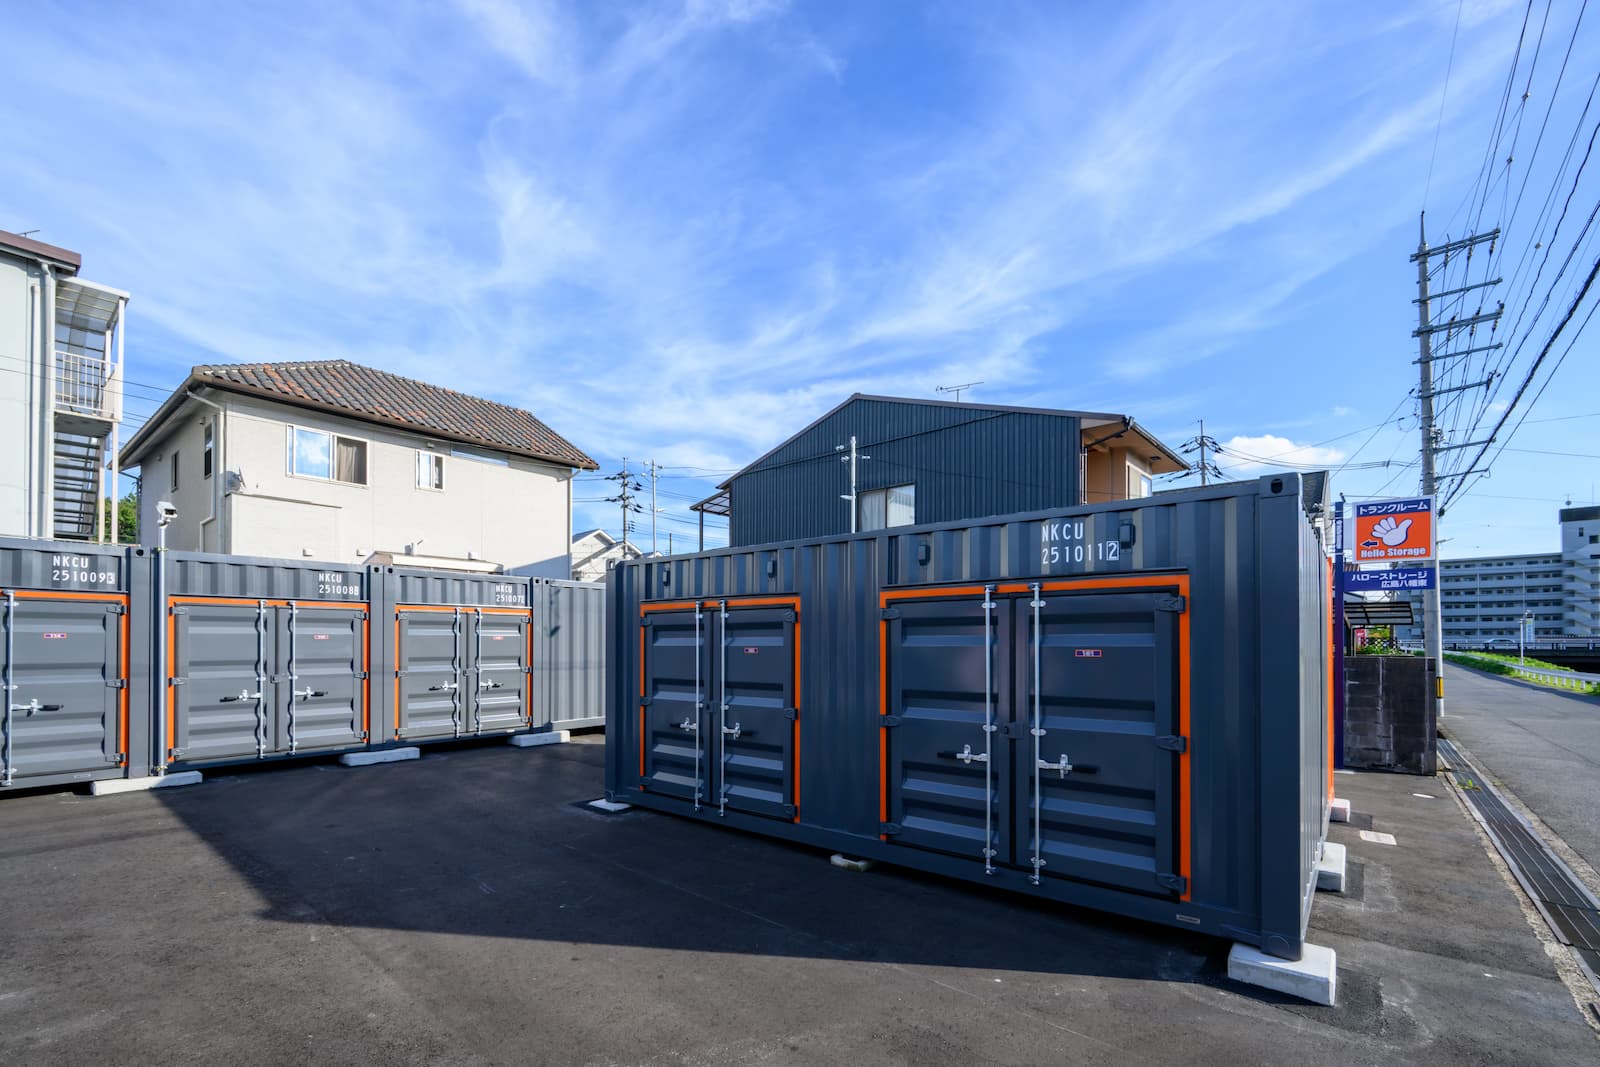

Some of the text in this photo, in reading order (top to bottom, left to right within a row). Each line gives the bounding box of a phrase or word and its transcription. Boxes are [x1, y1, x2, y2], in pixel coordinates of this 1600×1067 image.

[1359, 502, 1428, 515] トランクルーム
[1042, 522, 1083, 542] NKCU
[1042, 540, 1119, 565] 2510112
[1360, 547, 1426, 558] Hello Storage
[53, 556, 88, 568] NKCU
[53, 570, 115, 584] 2510093
[319, 573, 342, 582] NKCU
[1352, 570, 1428, 581] ハローストレージ
[496, 584, 512, 593] NKCU
